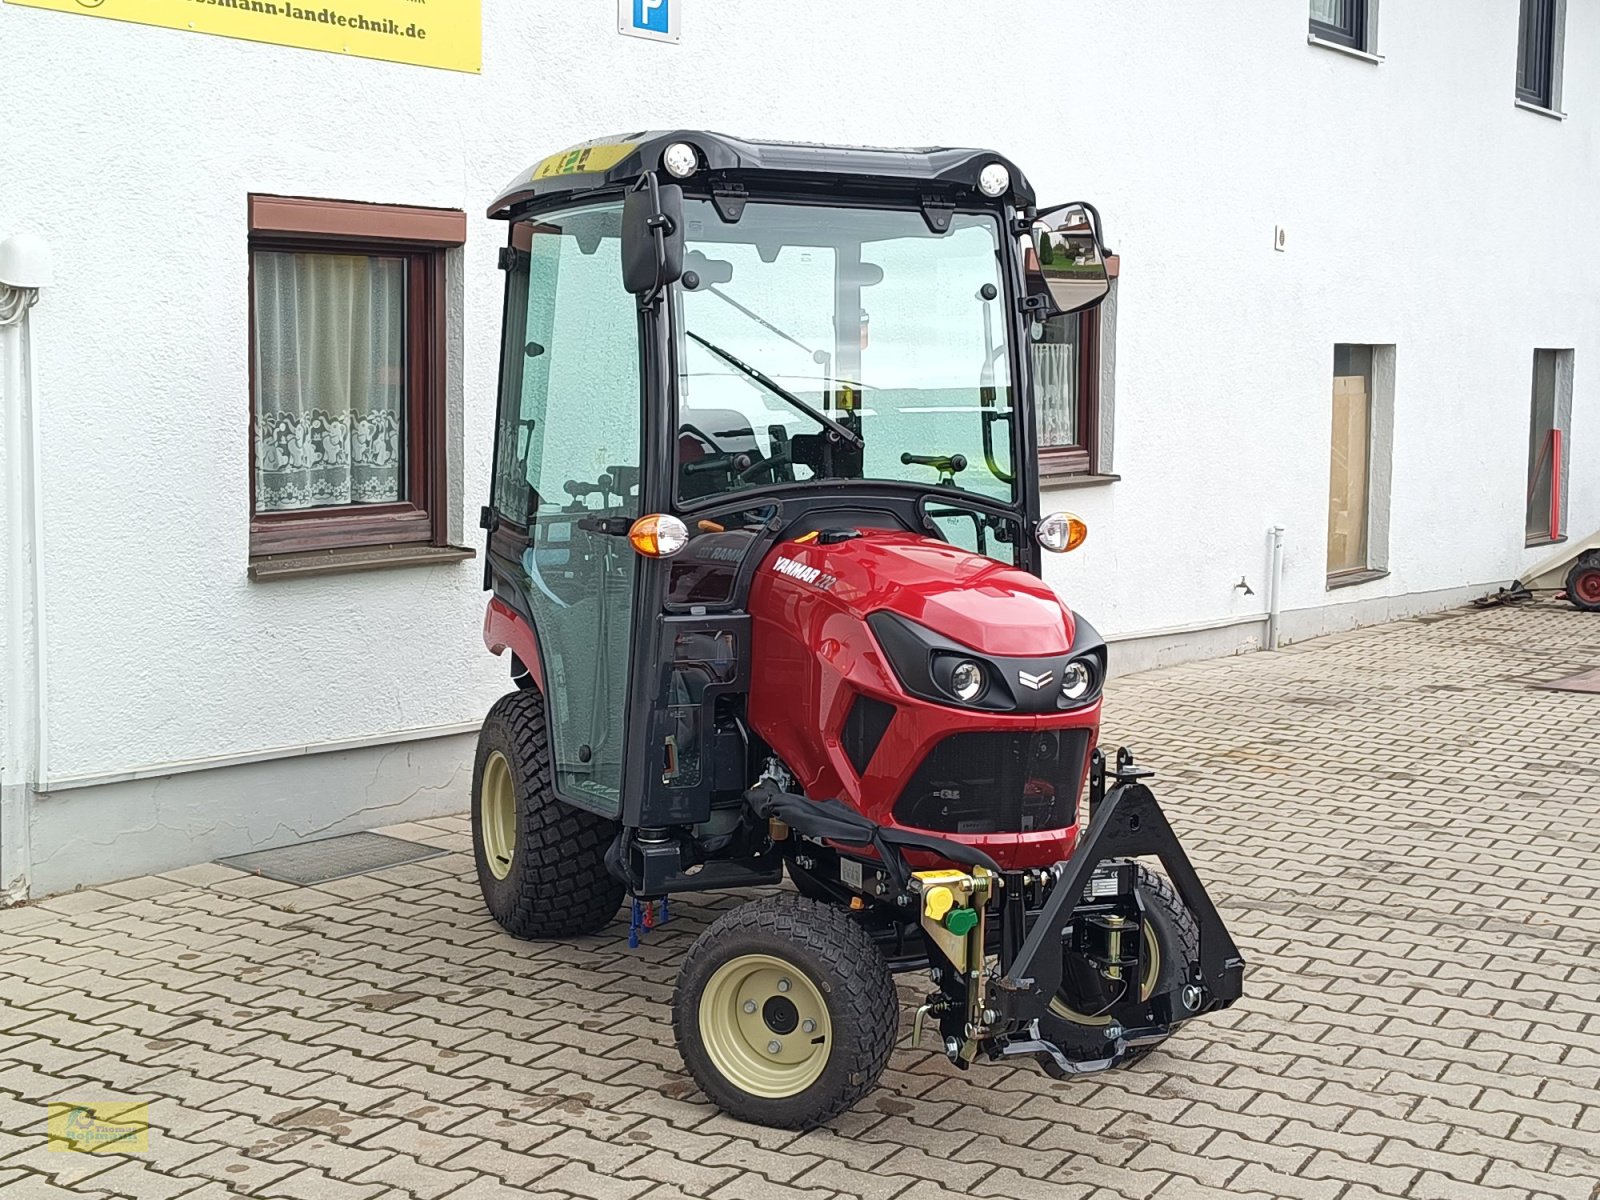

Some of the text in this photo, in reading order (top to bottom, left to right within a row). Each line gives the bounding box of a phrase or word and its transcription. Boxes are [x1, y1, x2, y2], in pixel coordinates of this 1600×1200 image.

[186, 0, 426, 39] smann-landtechnik.de
[641, 0, 664, 25] P
[772, 556, 837, 591] YANMAR 222
